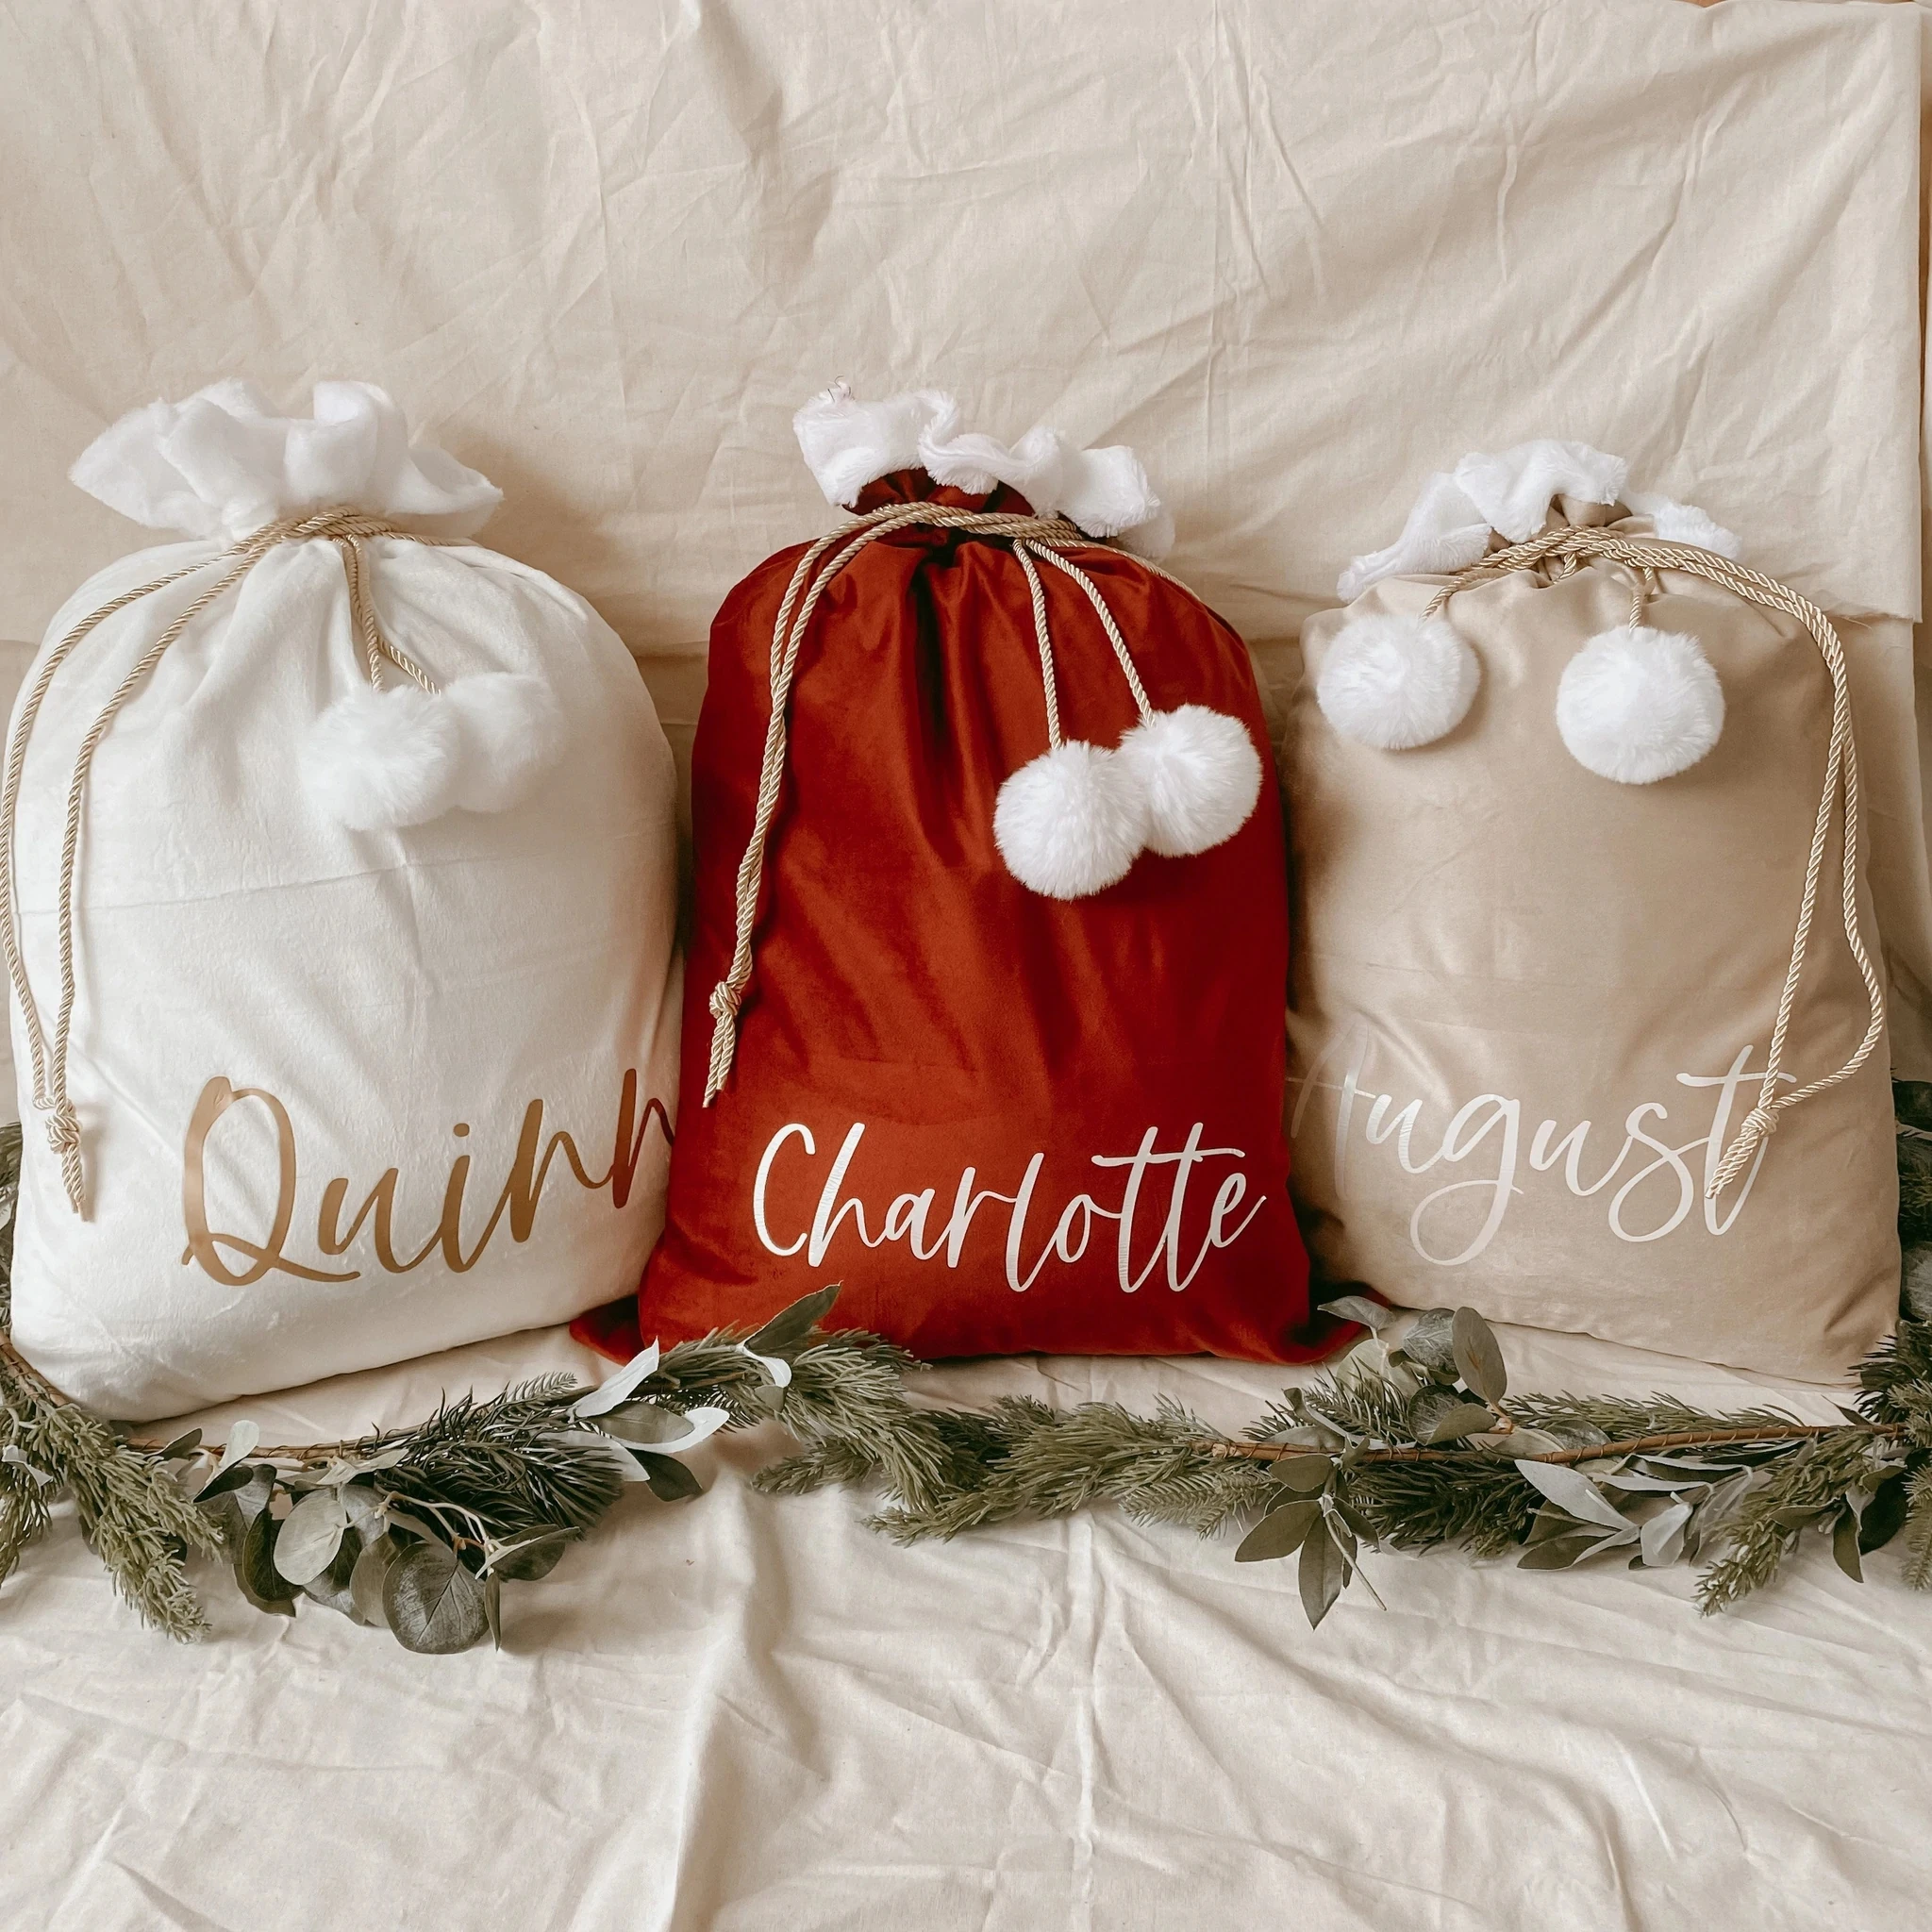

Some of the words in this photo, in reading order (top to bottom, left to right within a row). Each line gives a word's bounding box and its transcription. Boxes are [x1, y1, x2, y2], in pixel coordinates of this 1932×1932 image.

[182, 1068, 675, 1286] Quinn
[754, 1122, 1267, 1293] Charlotte
[1285, 1013, 1797, 1266] August
